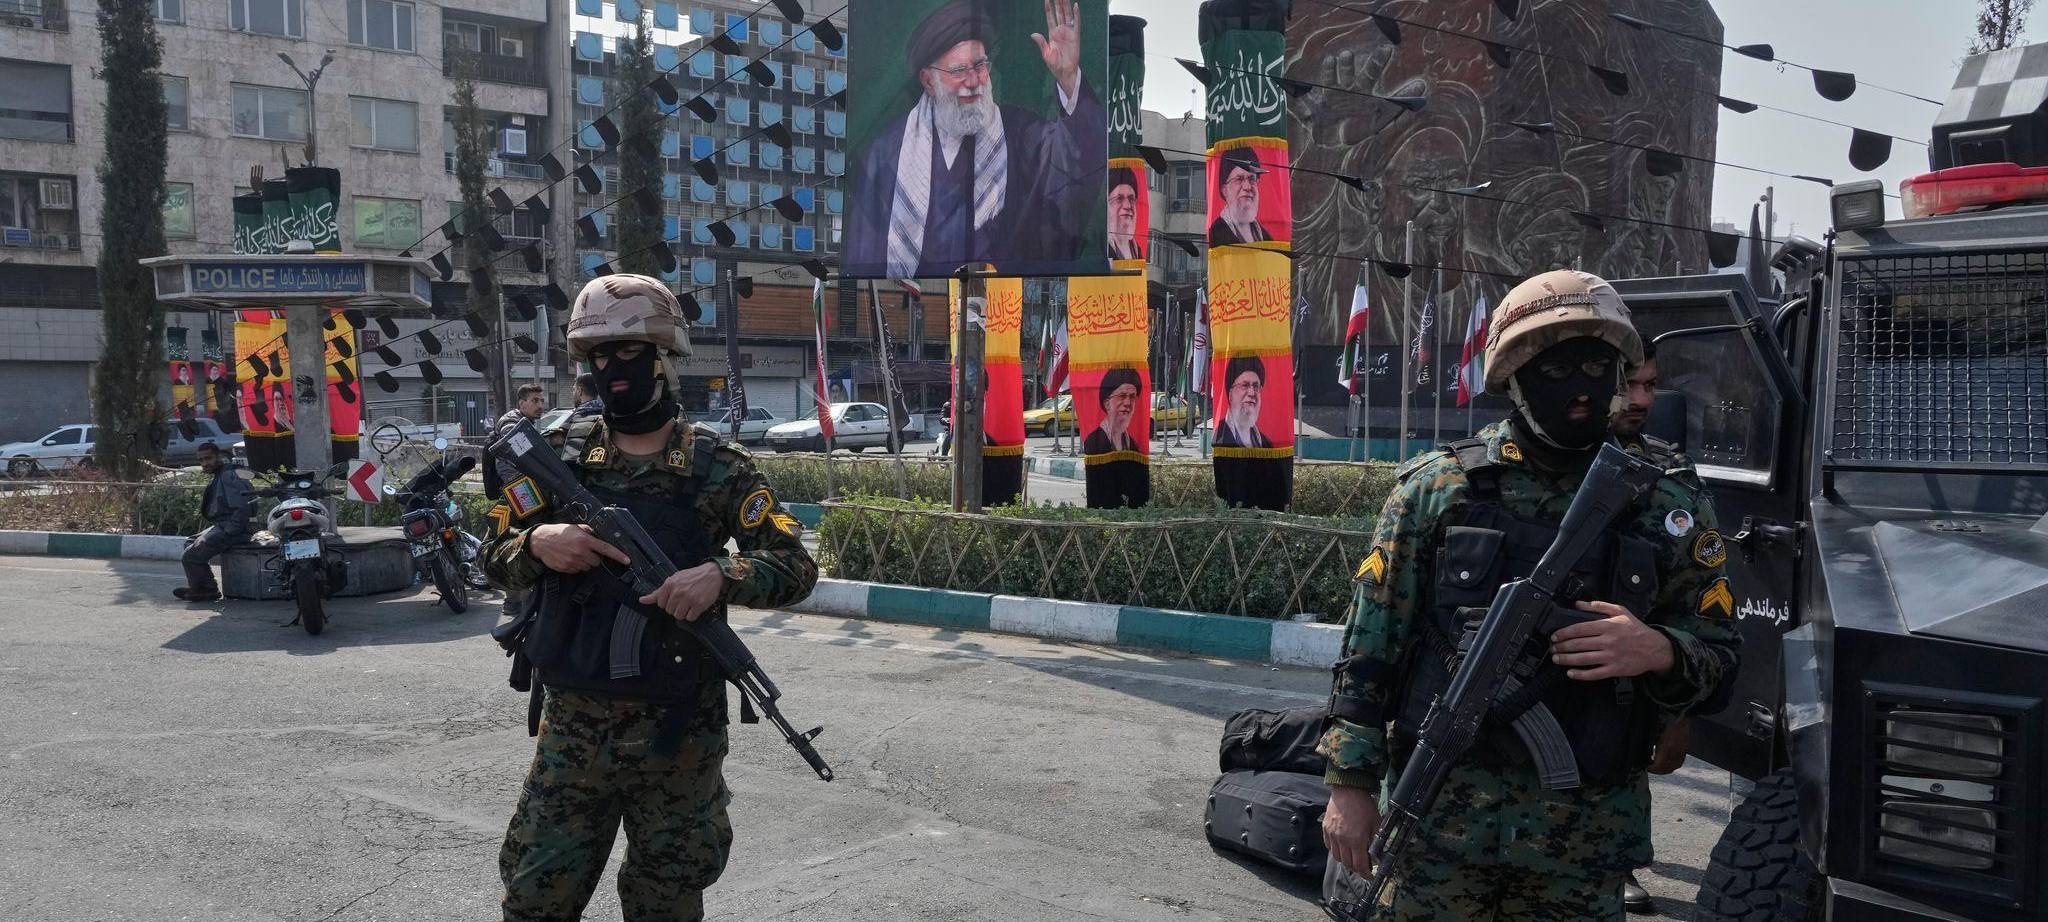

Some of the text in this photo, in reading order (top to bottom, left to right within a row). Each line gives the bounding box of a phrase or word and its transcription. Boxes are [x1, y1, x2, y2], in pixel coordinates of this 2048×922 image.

[196, 268, 276, 289] POLICE
[296, 267, 324, 291] رانندگی
[325, 270, 331, 290] و
[1736, 597, 1789, 626] فرماندهی
